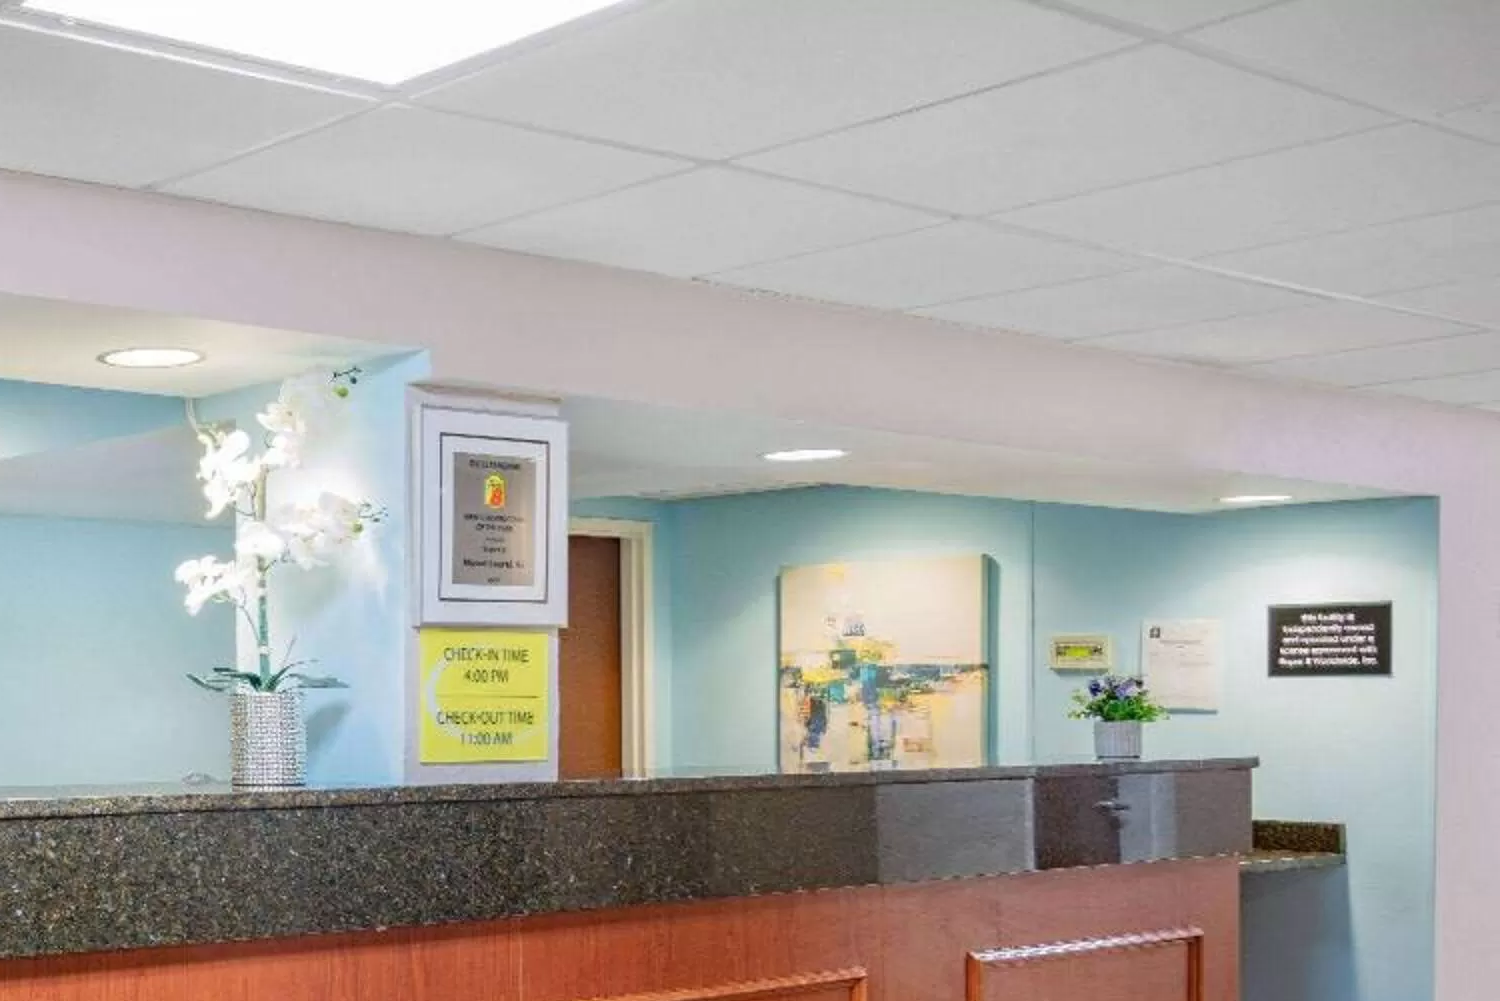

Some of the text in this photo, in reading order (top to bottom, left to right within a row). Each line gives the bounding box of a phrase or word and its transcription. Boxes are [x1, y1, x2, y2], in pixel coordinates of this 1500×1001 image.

[443, 647, 530, 663] CHECK-IN TIME
[464, 669, 509, 683] 4:00 PM
[436, 711, 535, 725] CHECK-OUT TIME
[461, 732, 513, 745] 11:00 AM
